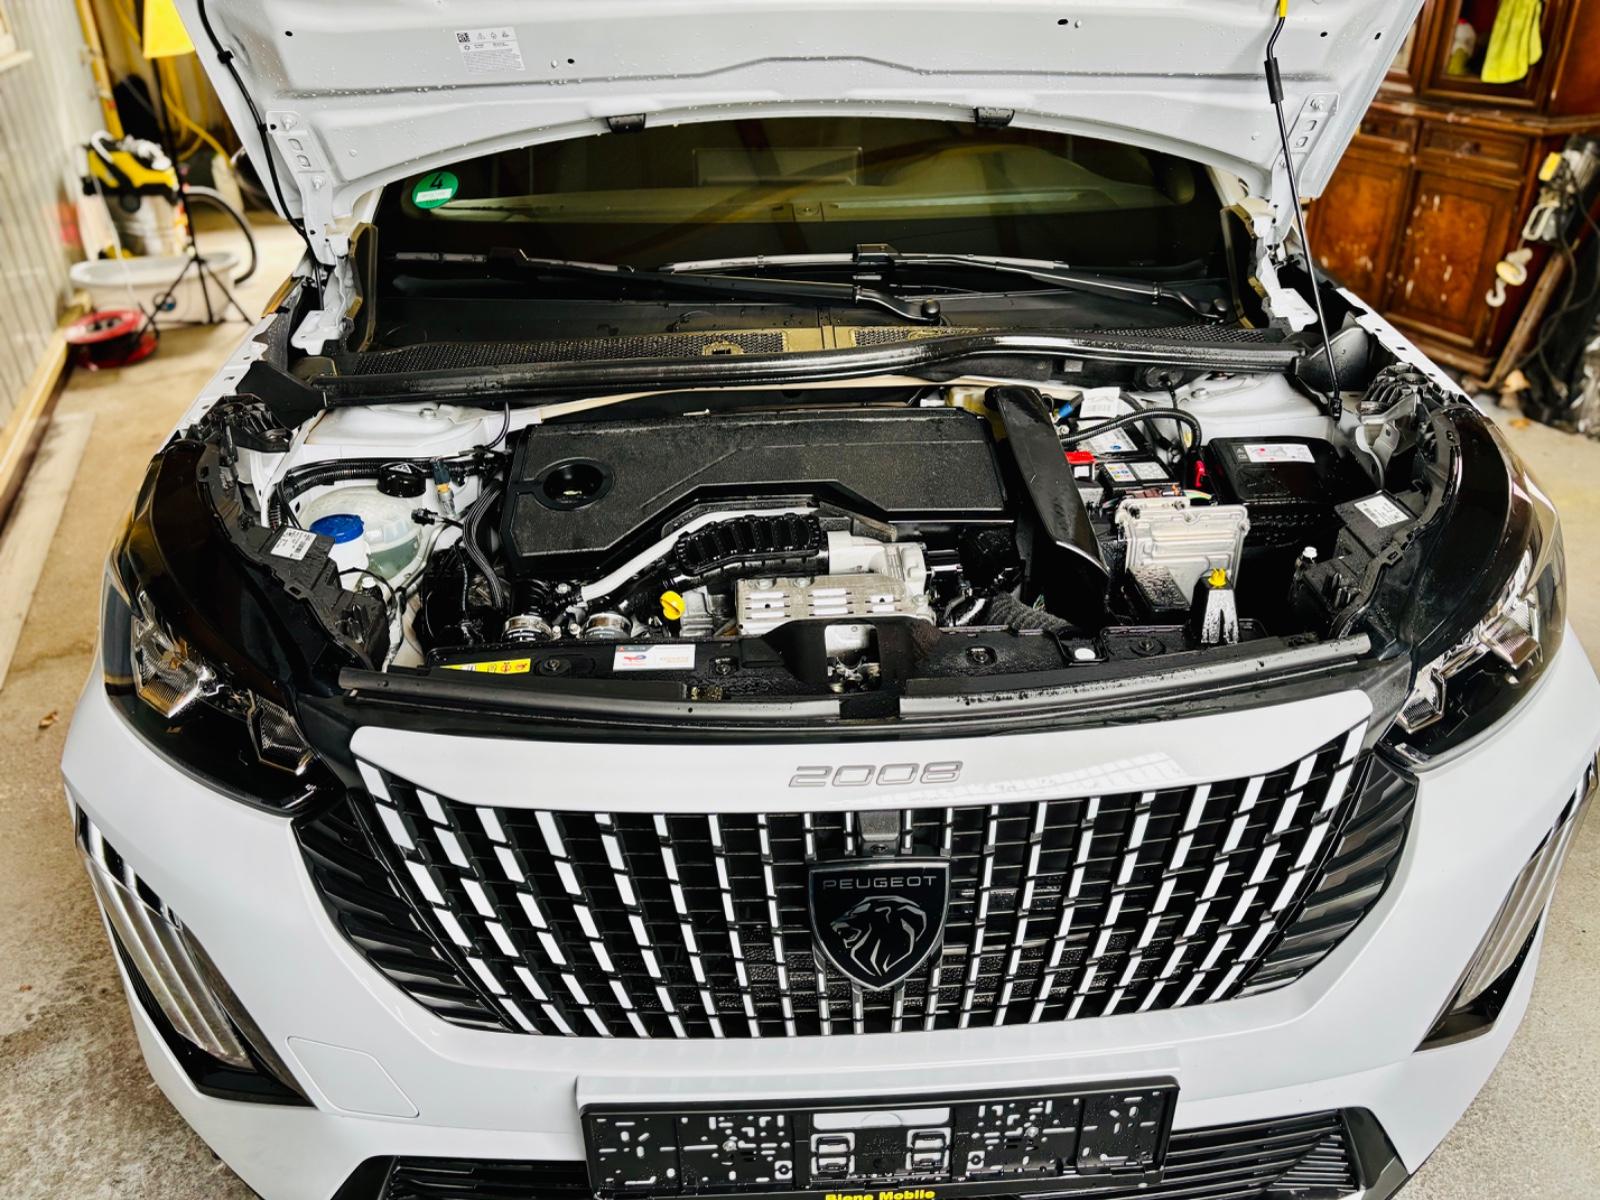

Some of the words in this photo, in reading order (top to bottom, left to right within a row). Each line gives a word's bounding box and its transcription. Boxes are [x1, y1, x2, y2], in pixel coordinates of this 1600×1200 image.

[430, 173, 443, 189] 4
[788, 760, 964, 788] 2008
[822, 875, 937, 890] PEUGEOT
[879, 1189, 936, 1200] Mobile
